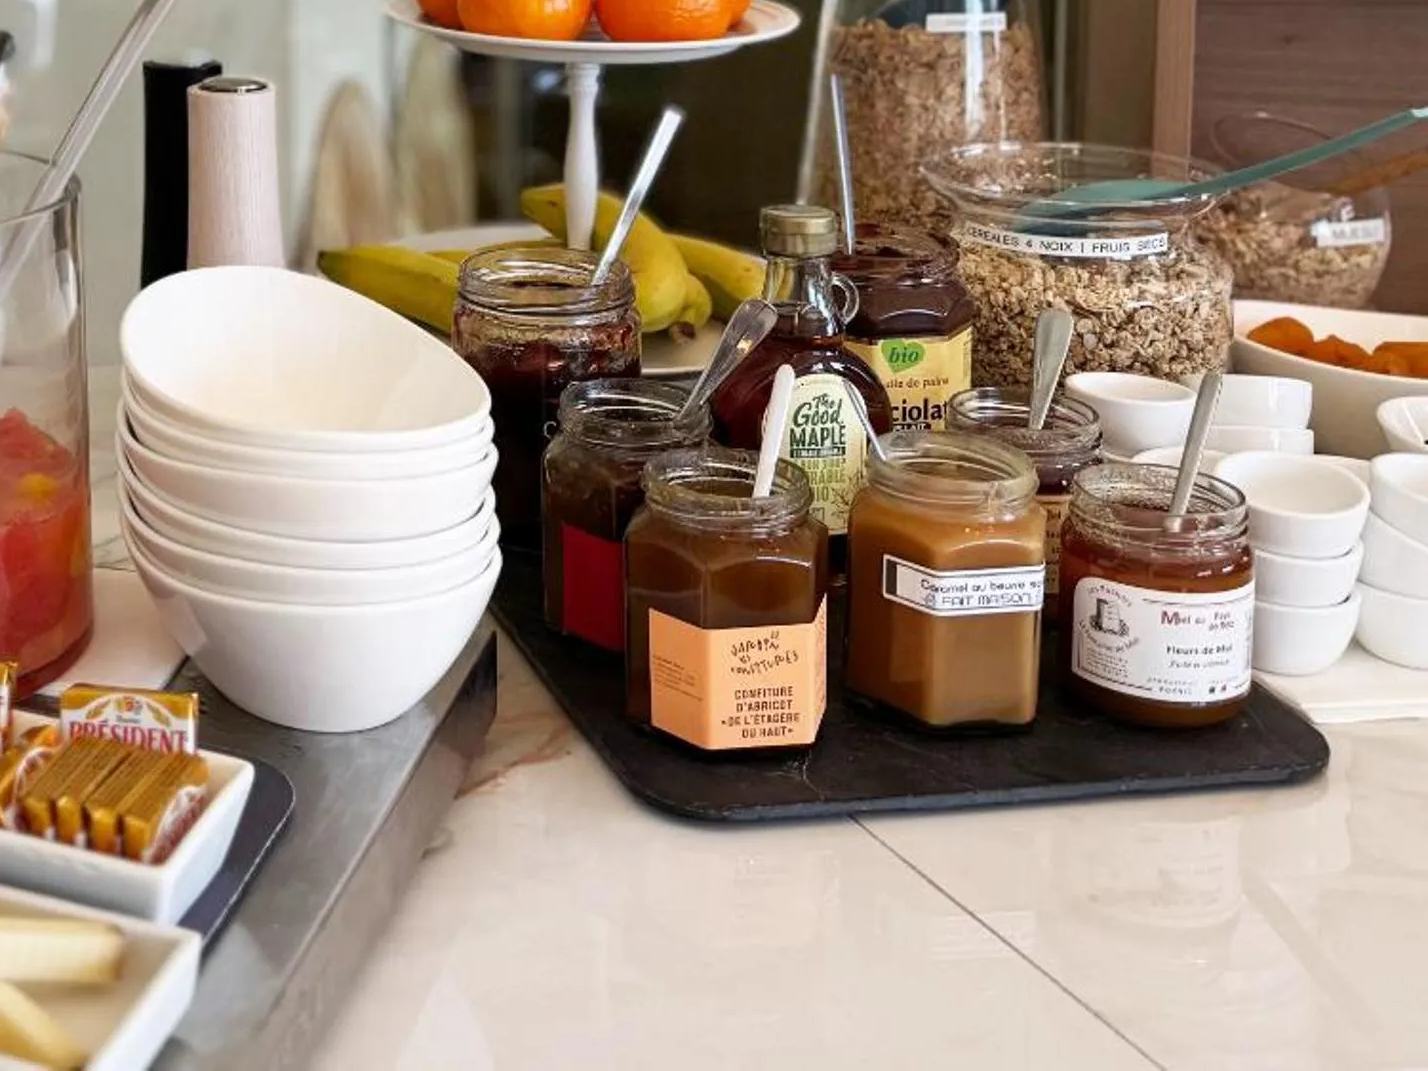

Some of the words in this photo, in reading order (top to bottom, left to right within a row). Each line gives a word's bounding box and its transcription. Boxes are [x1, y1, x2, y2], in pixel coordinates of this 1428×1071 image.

[1039, 240, 1073, 251] NOIX
[888, 347, 919, 363] bio
[811, 393, 835, 409] The
[789, 425, 846, 447] MAPLE
[734, 686, 794, 700] CONFITURE
